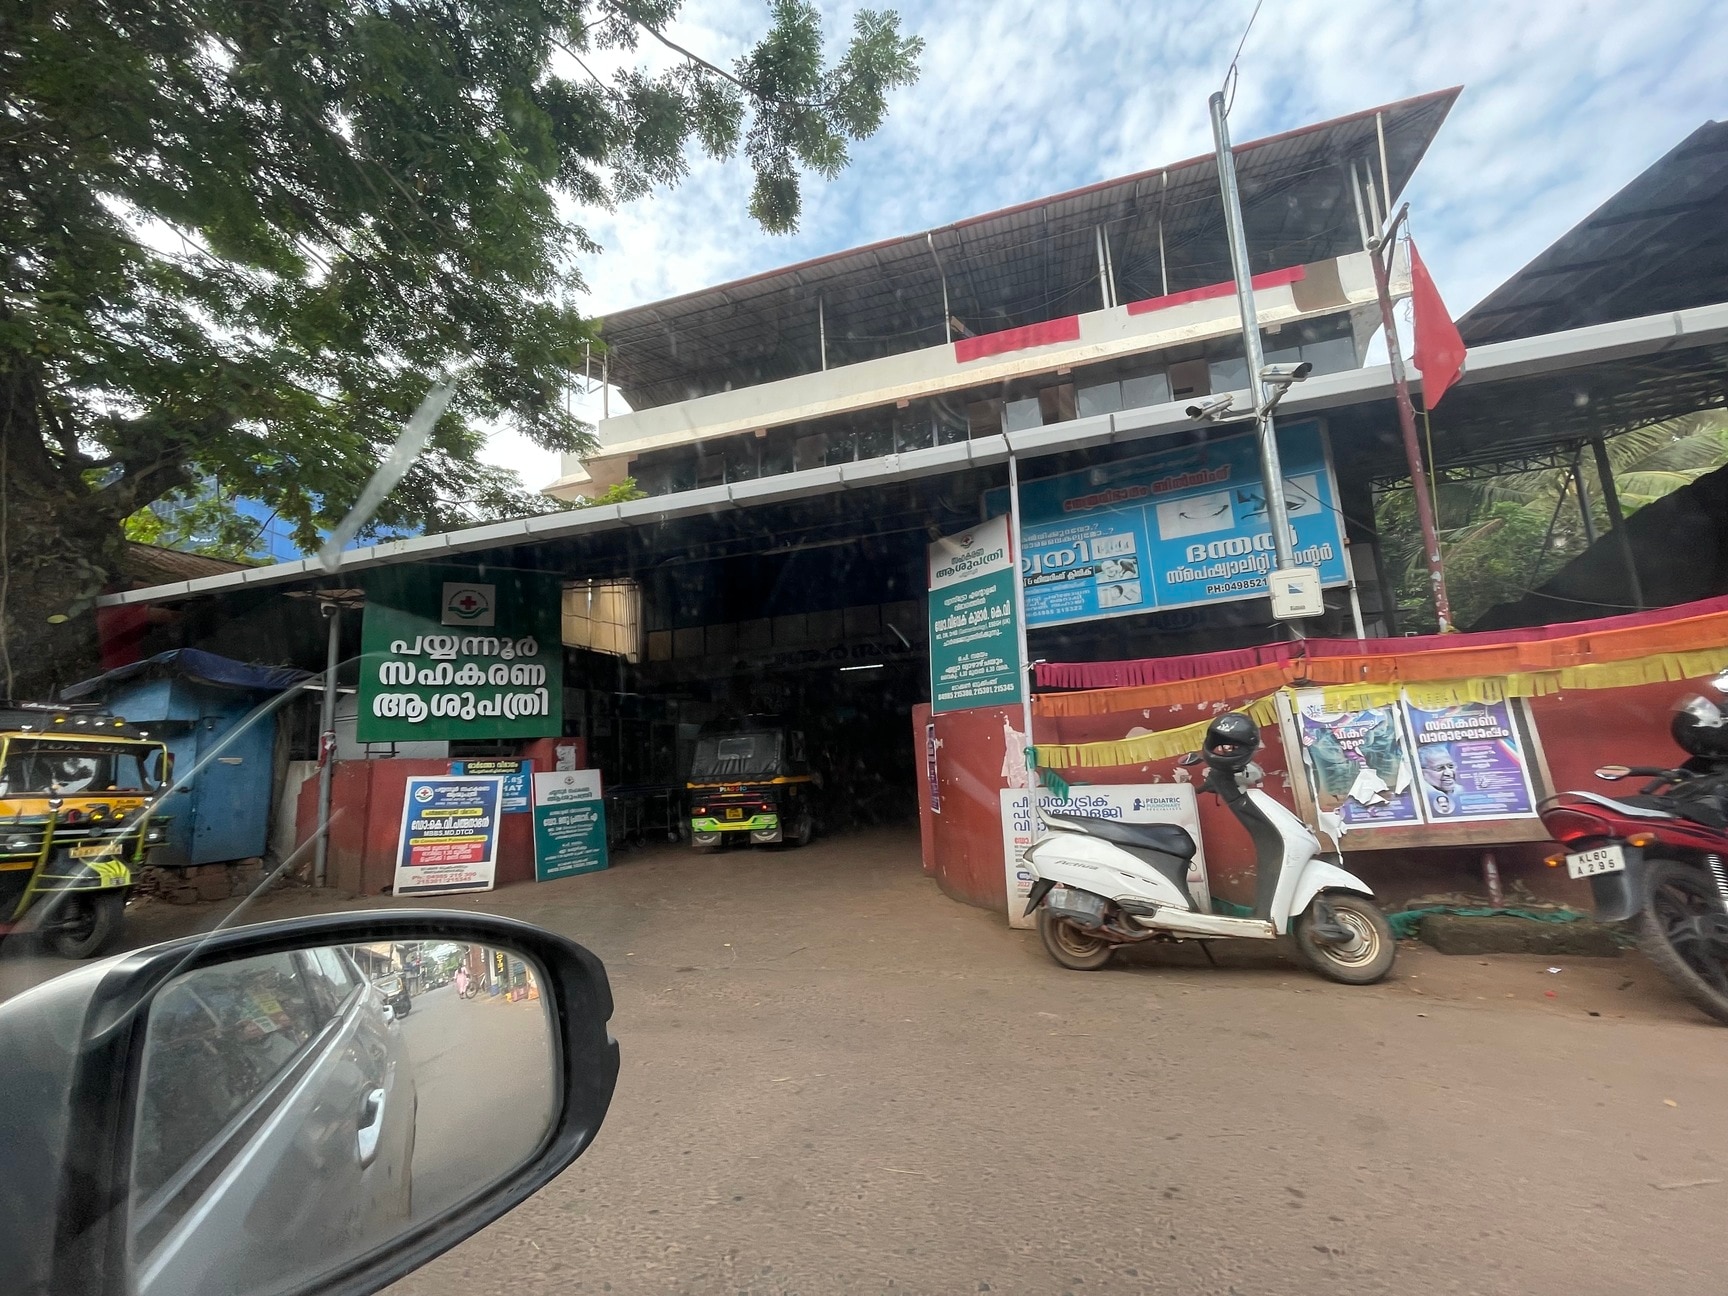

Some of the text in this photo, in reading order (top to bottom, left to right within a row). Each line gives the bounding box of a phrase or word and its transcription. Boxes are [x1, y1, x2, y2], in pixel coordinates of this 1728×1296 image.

[936, 548, 1004, 578] ആശുപത്രി
[390, 635, 538, 660] പയ്യന്നൂർ
[379, 661, 545, 686] സഹകരണ
[372, 688, 549, 723] ആശുപത്രി
[1419, 727, 1509, 743] വാരാഘോഷം
[1424, 716, 1497, 731] സഹകരണ
